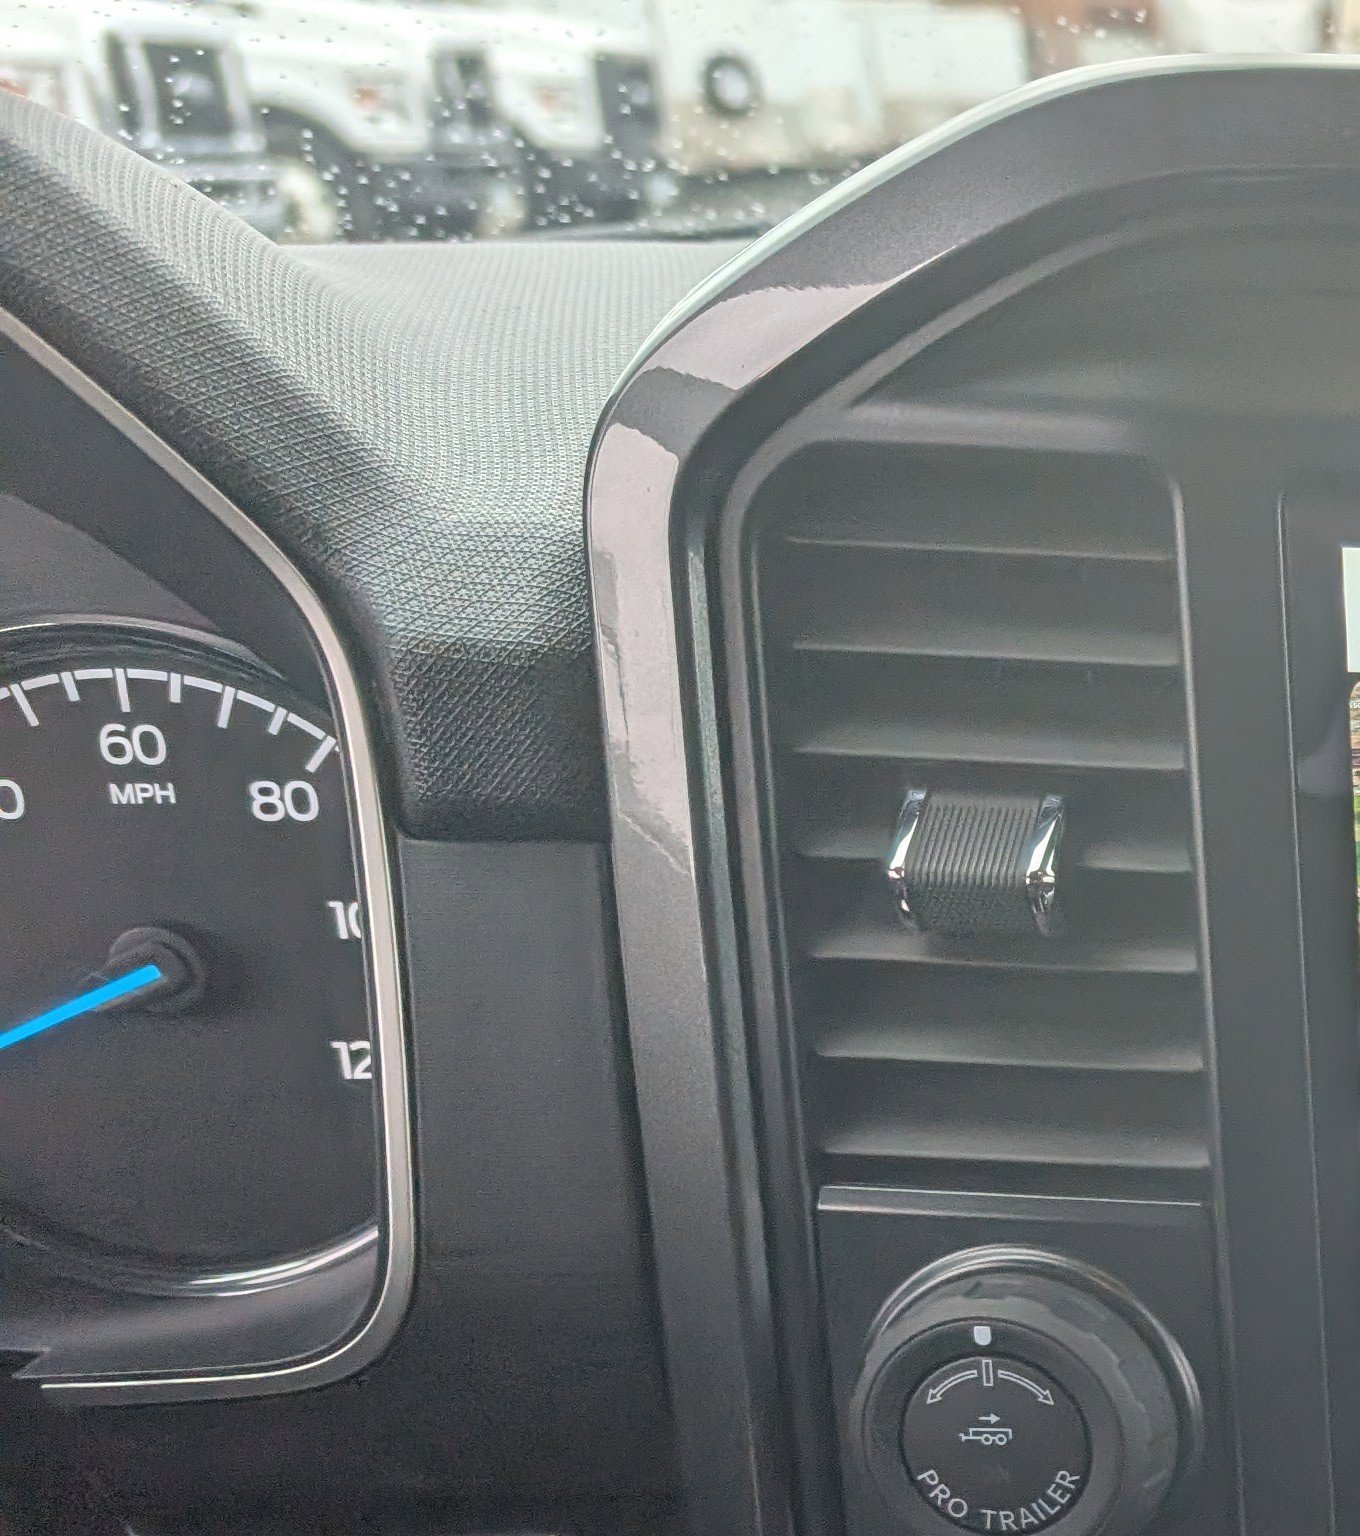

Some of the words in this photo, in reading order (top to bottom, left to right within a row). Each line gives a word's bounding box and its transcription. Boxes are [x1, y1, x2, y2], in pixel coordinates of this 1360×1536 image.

[99, 723, 168, 766] 60
[109, 782, 177, 805] MPH
[248, 780, 320, 822] 80
[917, 1468, 969, 1518] PRO
[981, 1468, 1081, 1532] TRAILER
